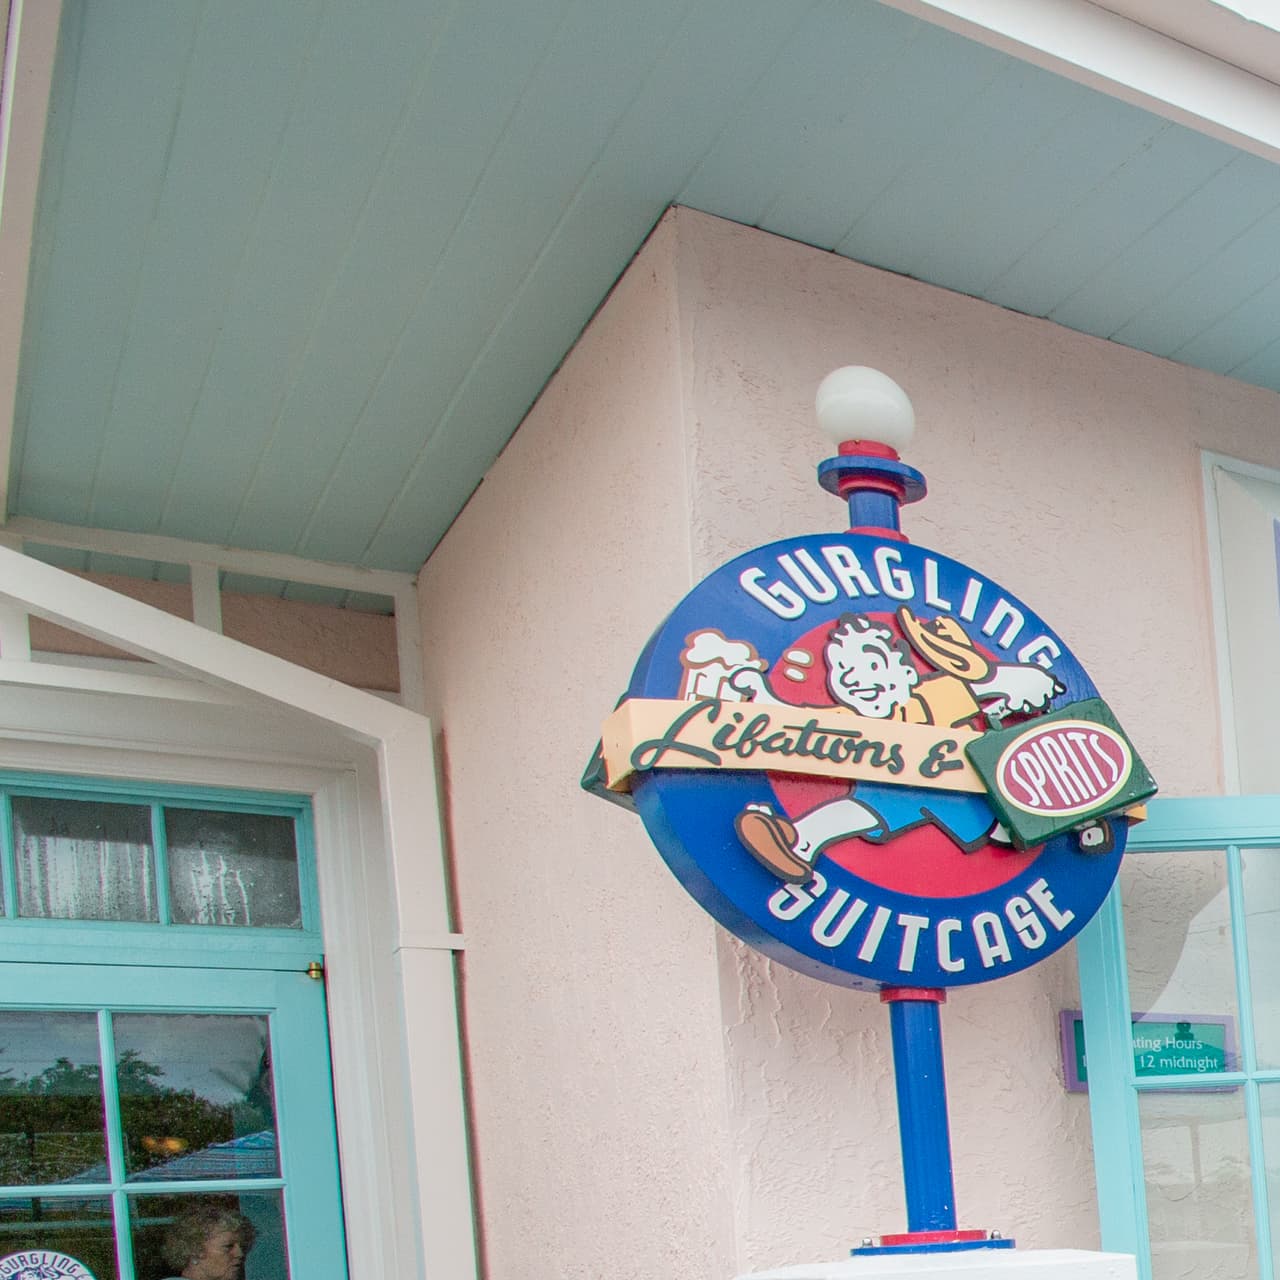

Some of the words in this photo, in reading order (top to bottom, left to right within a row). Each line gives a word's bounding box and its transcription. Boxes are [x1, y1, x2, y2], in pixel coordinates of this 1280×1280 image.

[740, 546, 1061, 674] GURGLING
[630, 700, 905, 774] Libations
[919, 740, 963, 778] &
[1011, 731, 1119, 807] SPIRITS
[767, 873, 1075, 974] SUITCASE
[1132, 1037, 1161, 1052] ting
[1166, 1037, 1203, 1050] Hours
[1140, 1055, 1155, 1068] 12
[1160, 1055, 1218, 1072] midnight
[0, 1253, 80, 1275] GURGLING
